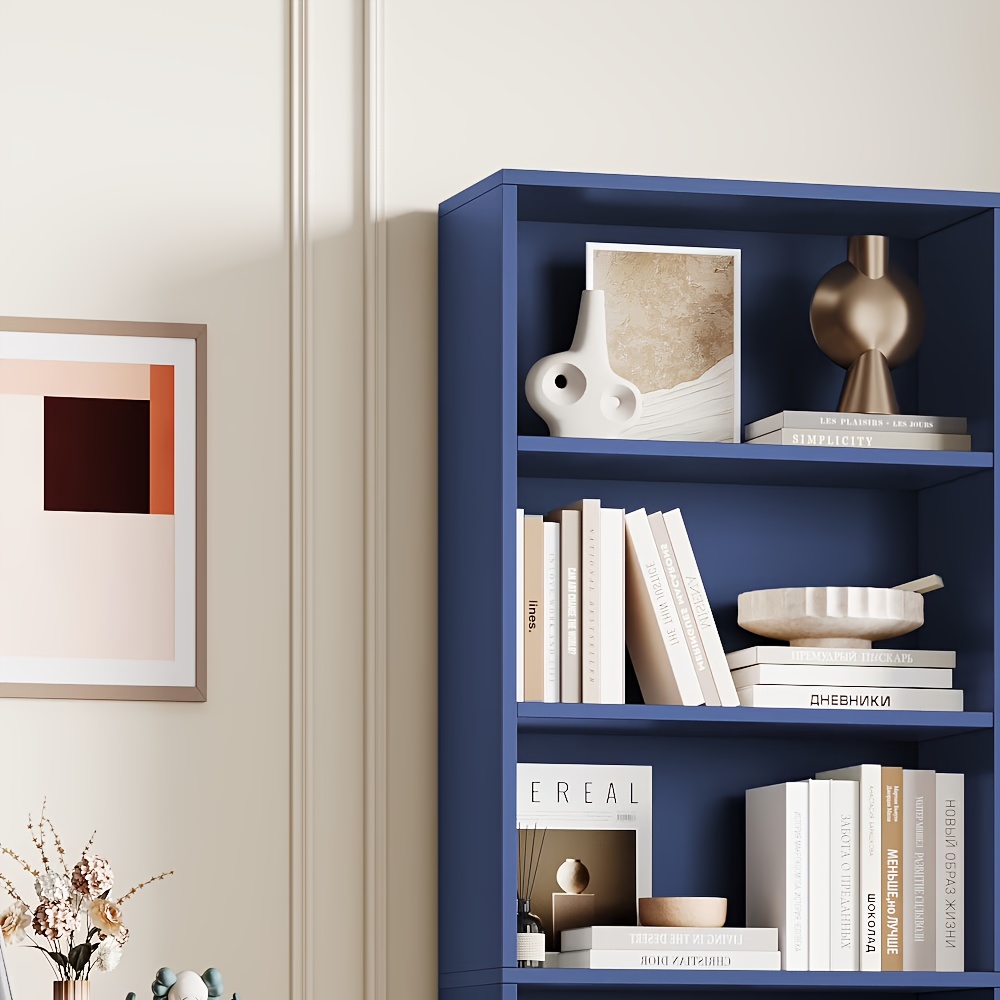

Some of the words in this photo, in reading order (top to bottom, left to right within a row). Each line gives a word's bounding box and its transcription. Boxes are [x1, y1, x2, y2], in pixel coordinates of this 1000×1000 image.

[819, 416, 837, 425] LES
[840, 418, 884, 426] PLAISIRS
[893, 420, 908, 428] LES
[909, 421, 934, 429] JOURS
[792, 433, 873, 447] SIMPLICITY
[567, 567, 577, 580] CAN
[588, 528, 596, 592] NATIONAL
[567, 580, 577, 593] ART
[528, 600, 539, 633] lines.
[567, 593, 577, 618] CHANGE
[567, 618, 577, 630] THE
[588, 600, 596, 685] BESTSELLER
[791, 649, 857, 662] ПРЕМУДРЫЙ
[861, 651, 914, 663] ПИСКАРЬ
[810, 694, 891, 707] ДНЕВНИКИ
[531, 781, 639, 804] EREAL
[840, 814, 851, 858] ЗАБОТА
[944, 799, 958, 848] НОВЫЙ
[840, 862, 851, 871] О
[913, 852, 925, 895] РАЗВИТИЕ
[944, 852, 956, 895] ОБРАЗ
[839, 875, 851, 949] ПРЕДАННЫХ
[865, 893, 876, 953] ШОКОЛАД
[944, 898, 956, 949] ЖИЗНИ
[886, 916, 899, 955] ЛУЧШЕ
